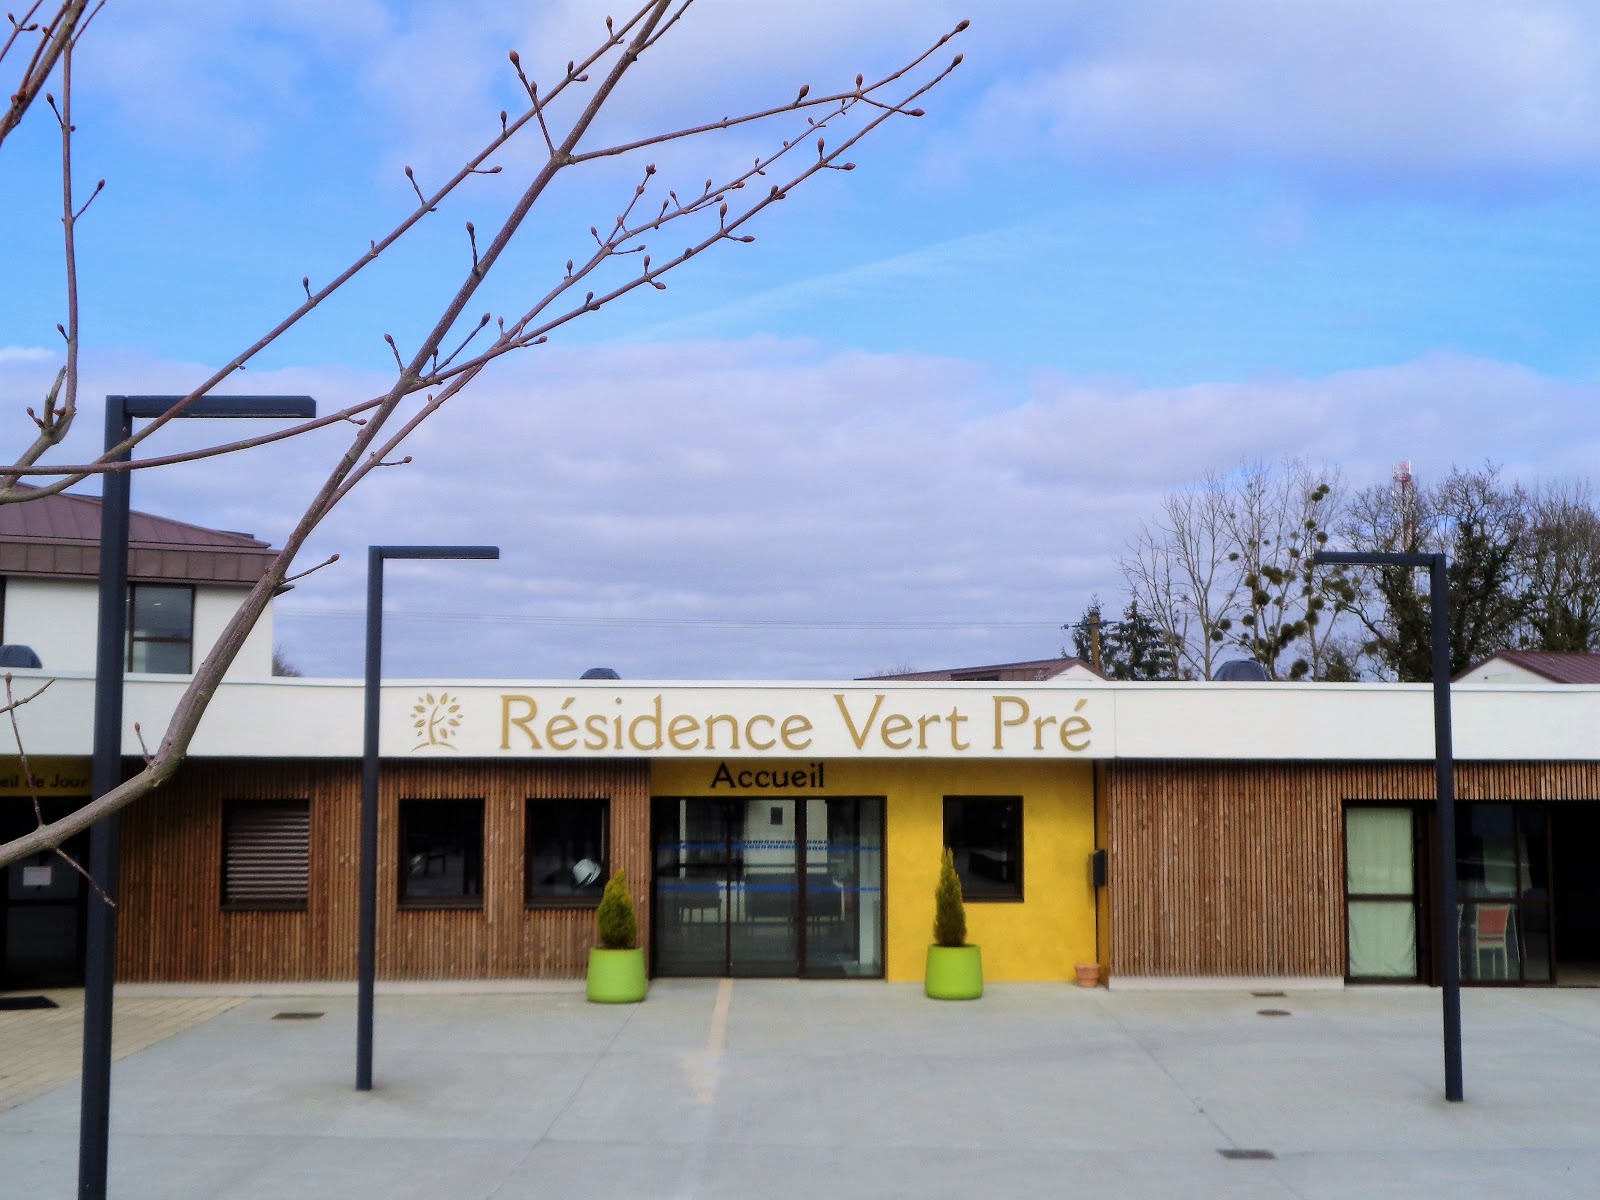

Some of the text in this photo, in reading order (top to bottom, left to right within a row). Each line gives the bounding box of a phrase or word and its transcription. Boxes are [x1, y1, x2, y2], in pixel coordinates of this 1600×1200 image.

[500, 694, 1092, 750] Résidence Vert Pré
[50, 774, 88, 788] Jour
[711, 762, 825, 788] Accueil
